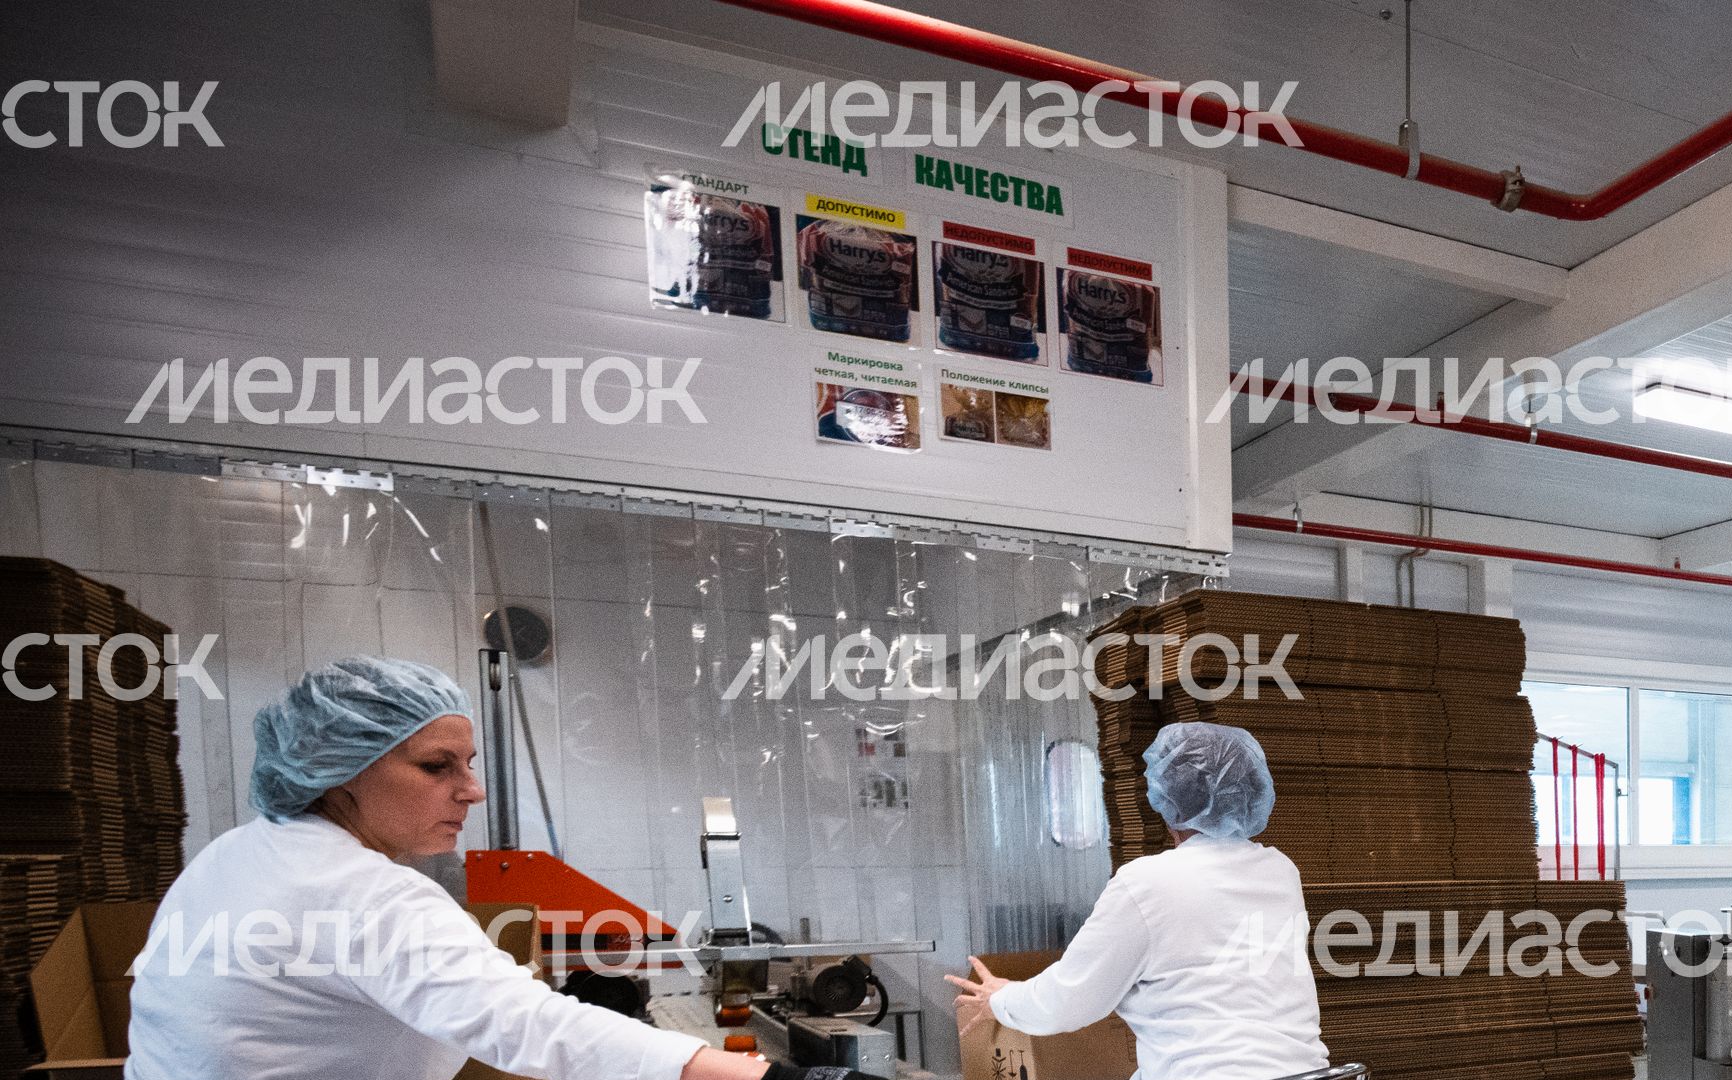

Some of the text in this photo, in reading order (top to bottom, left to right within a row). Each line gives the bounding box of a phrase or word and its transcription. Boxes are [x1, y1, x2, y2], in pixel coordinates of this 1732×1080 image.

[761, 123, 1065, 216] СТЕНД КАЧЕСТВА
[816, 199, 896, 223] ДОПУСТИМО
[829, 238, 887, 262] Harrys
[827, 351, 903, 372] Маркировка
[814, 367, 918, 389] четкая, читаемая
[941, 369, 1049, 395] Положение клипсы
